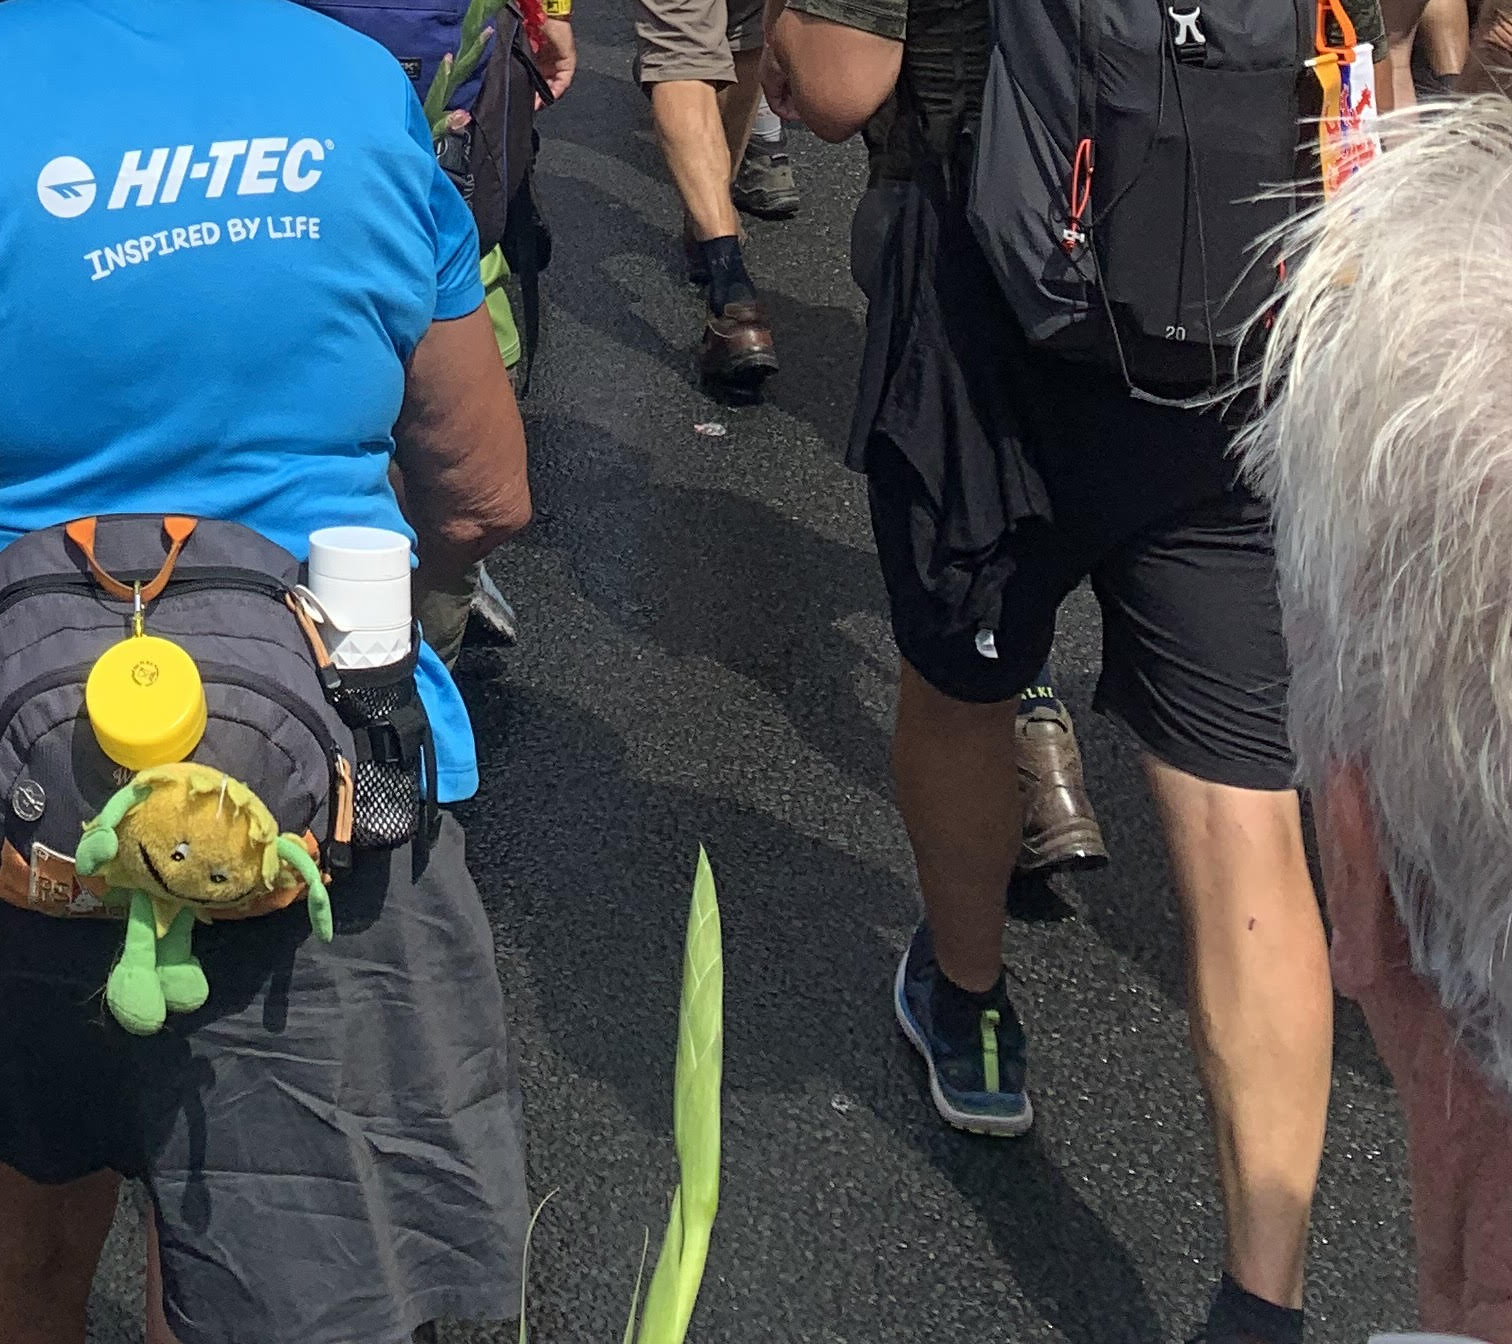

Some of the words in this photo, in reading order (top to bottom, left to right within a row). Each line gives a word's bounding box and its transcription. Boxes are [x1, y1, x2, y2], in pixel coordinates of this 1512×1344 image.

[106, 136, 325, 210] HI-TEC
[83, 221, 221, 281] INSPIRED
[226, 216, 261, 242] BY
[266, 215, 321, 239] LIFE
[1165, 325, 1186, 341] 20
